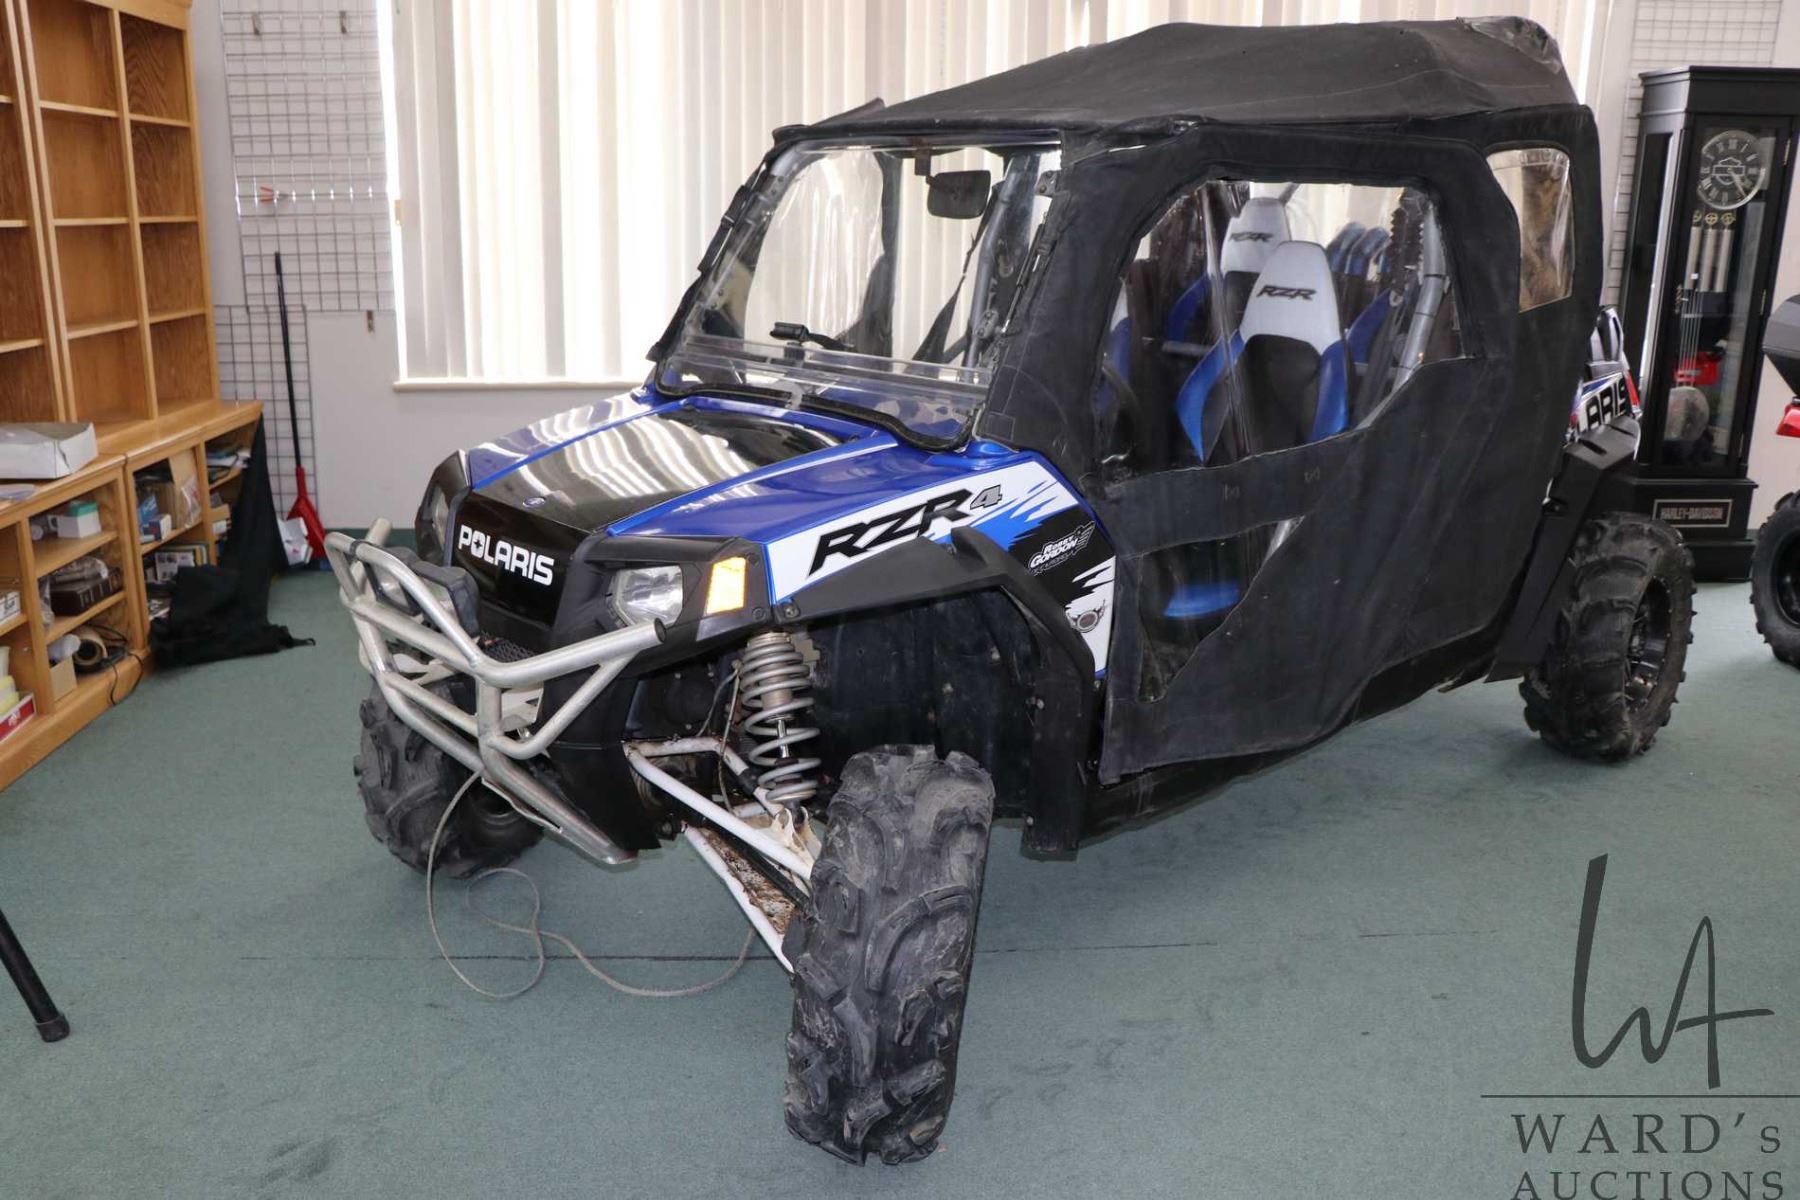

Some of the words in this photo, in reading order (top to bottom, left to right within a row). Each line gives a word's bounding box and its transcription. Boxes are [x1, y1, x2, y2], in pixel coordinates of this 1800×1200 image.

[1229, 231, 1274, 242] RZR
[1257, 284, 1317, 300] RZR
[808, 488, 974, 577] RZR
[970, 484, 1003, 510] 4
[458, 524, 555, 587] POLARIS
[1030, 537, 1079, 569] GORDON
